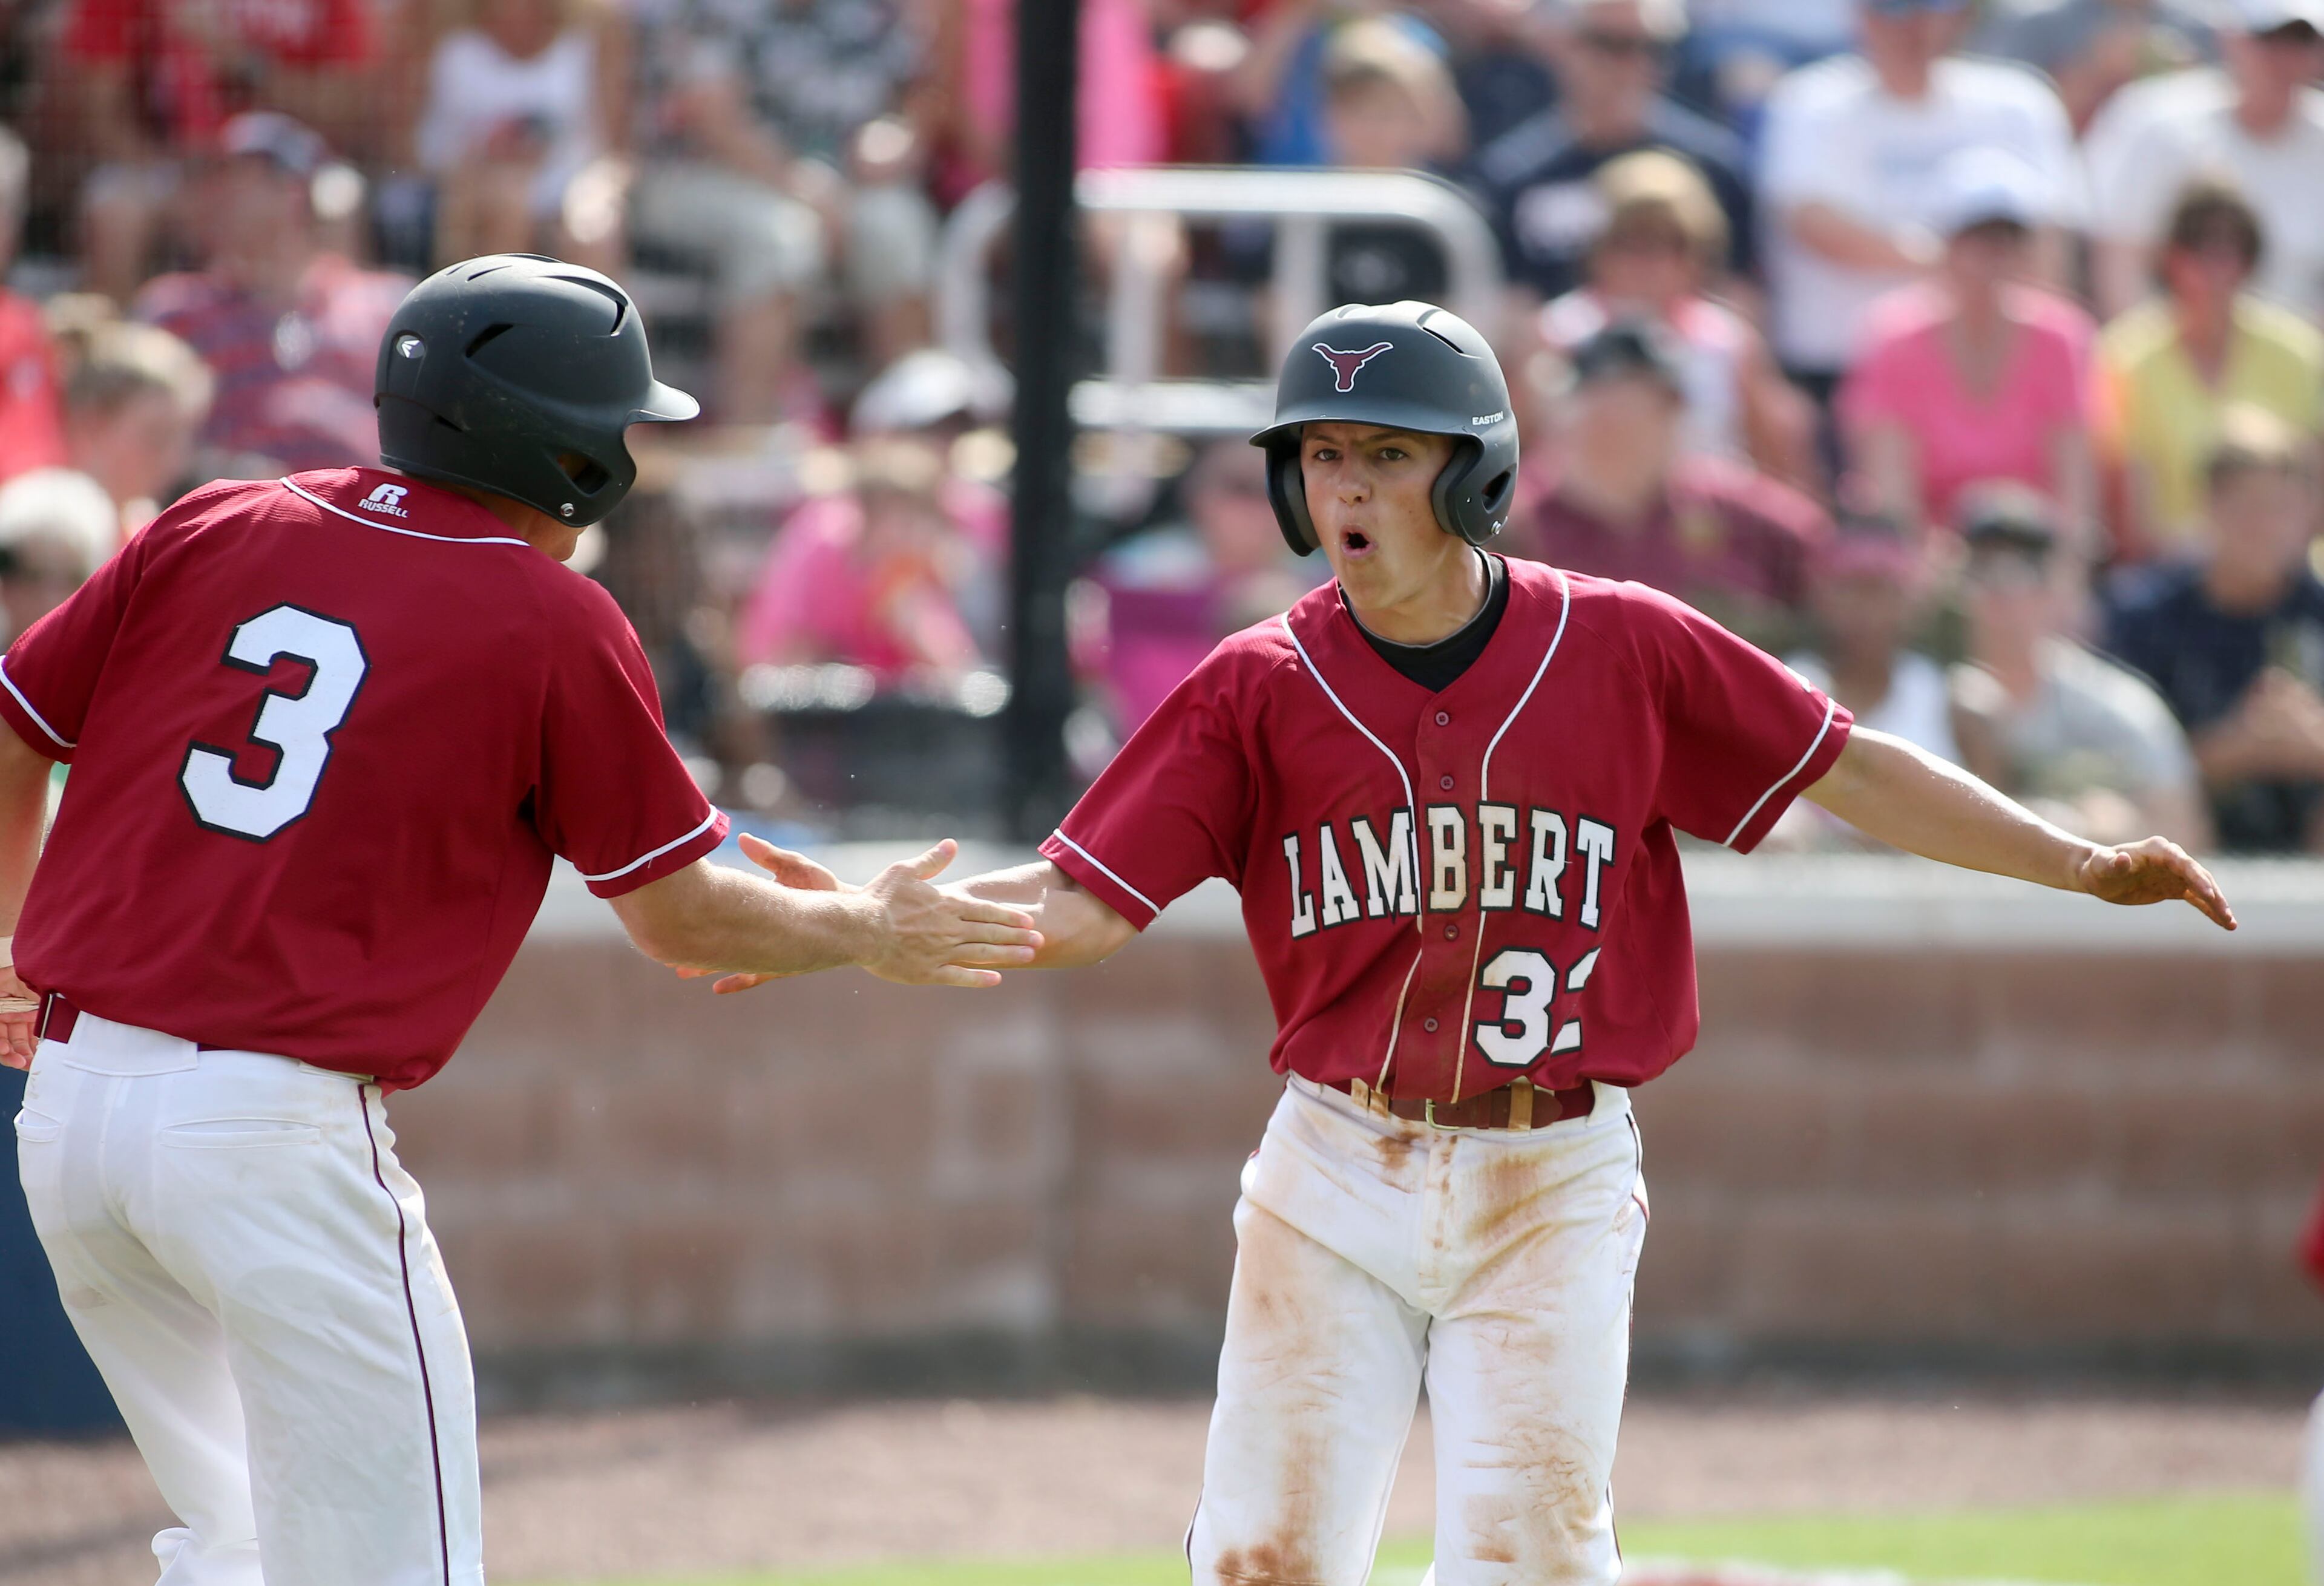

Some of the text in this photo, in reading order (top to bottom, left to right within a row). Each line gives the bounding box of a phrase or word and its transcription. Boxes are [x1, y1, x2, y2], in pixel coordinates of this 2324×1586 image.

[1472, 411, 1504, 425] EASTON
[358, 498, 409, 518] RUSSELL
[177, 601, 371, 843] 3
[1283, 801, 1615, 939] LAMBERT
